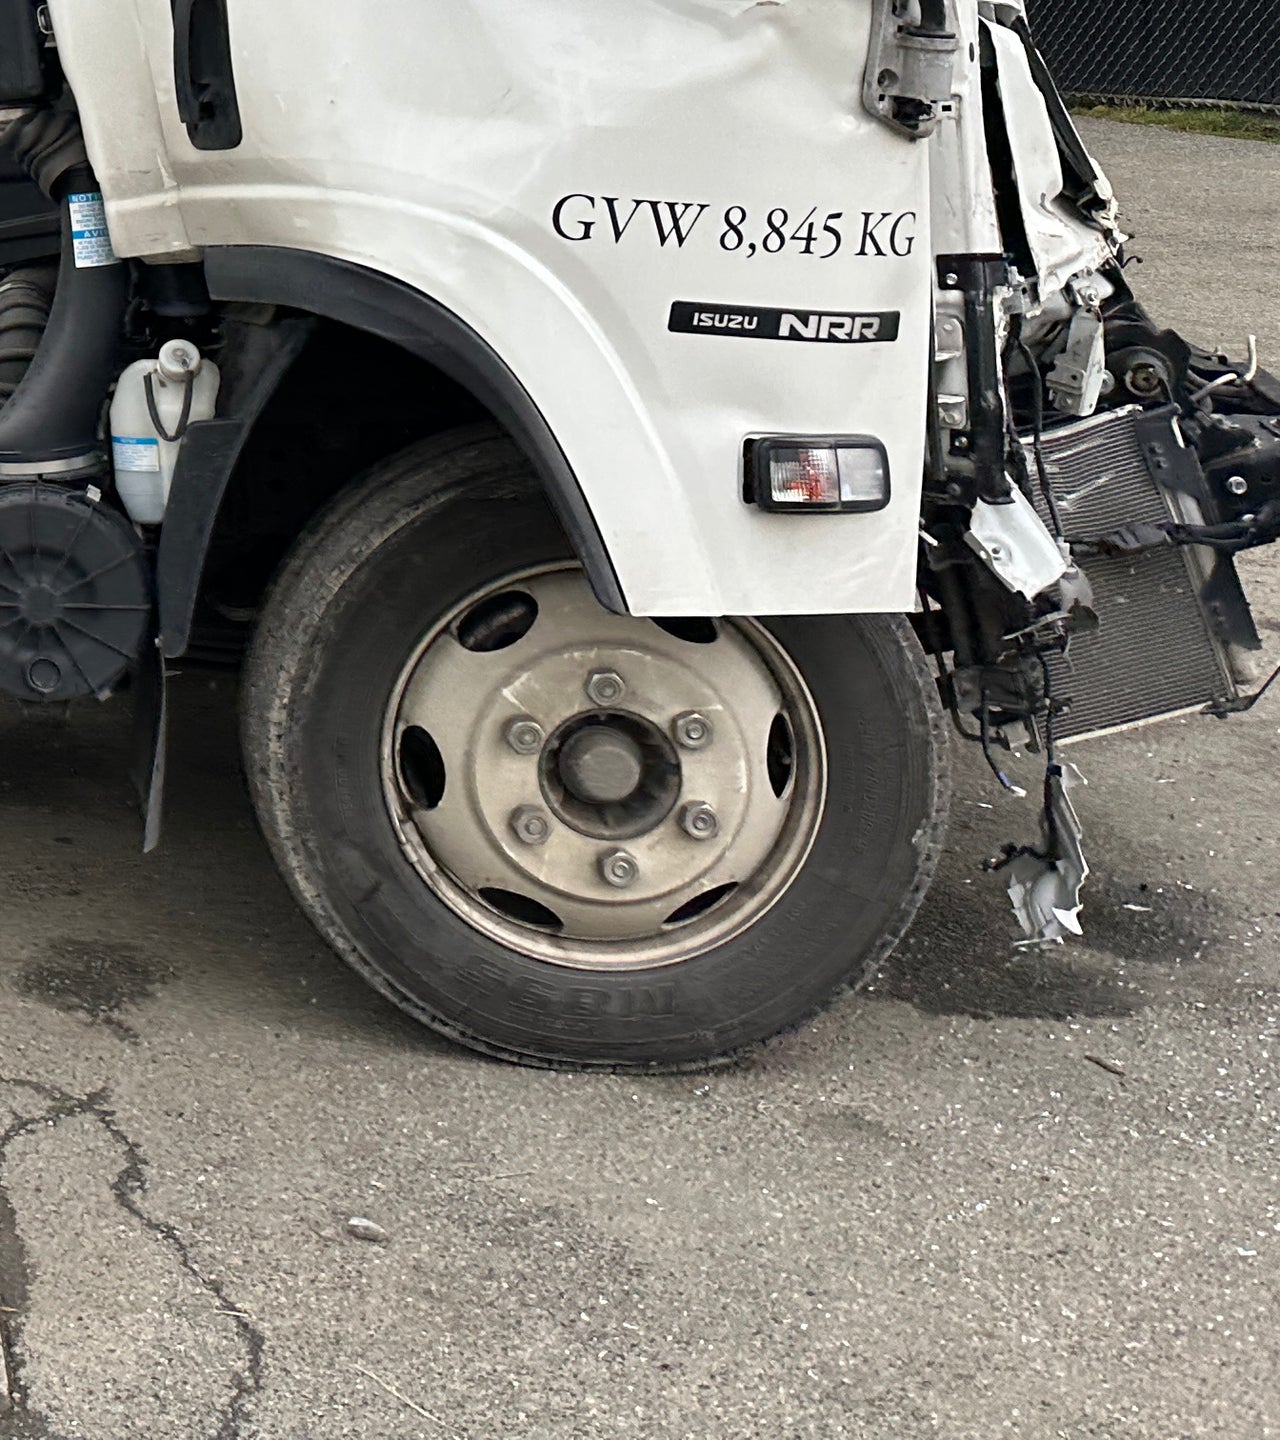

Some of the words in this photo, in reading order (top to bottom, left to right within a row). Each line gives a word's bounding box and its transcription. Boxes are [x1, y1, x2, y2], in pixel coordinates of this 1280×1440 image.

[551, 193, 710, 248] GVW
[718, 205, 844, 259] 8,845
[854, 210, 917, 257] KG
[691, 311, 759, 330] ISUZU
[777, 313, 881, 340] NRR
